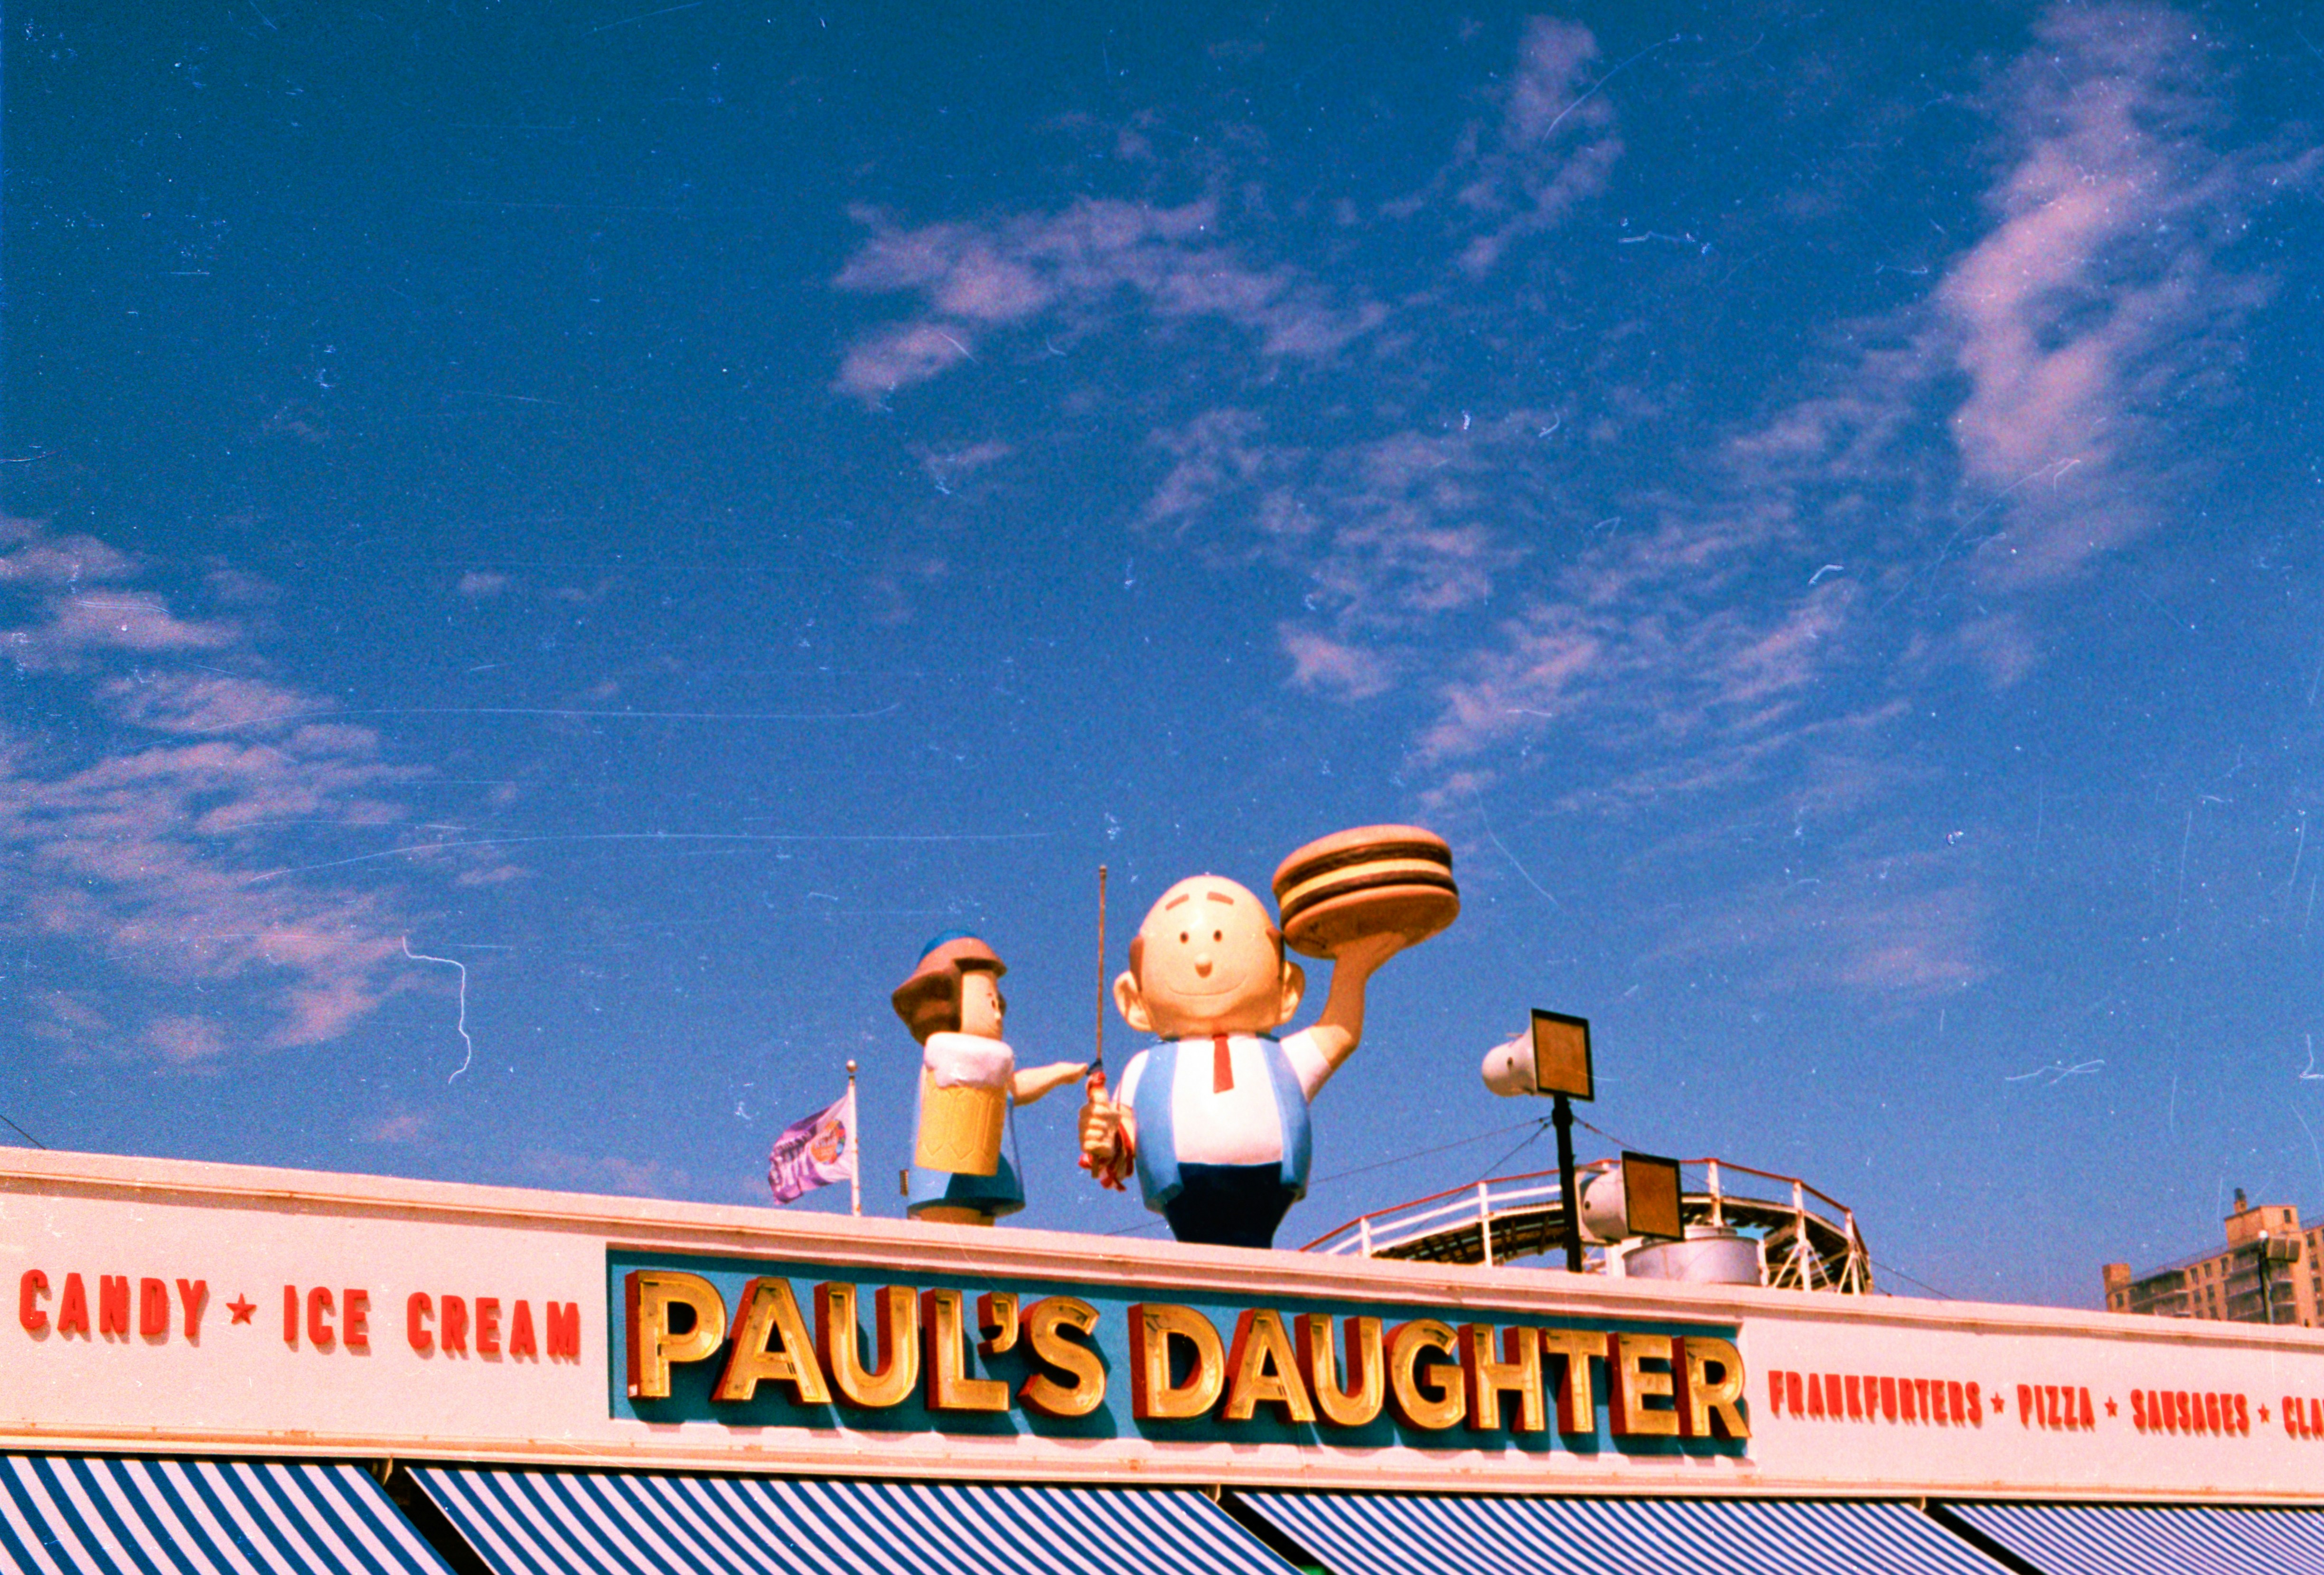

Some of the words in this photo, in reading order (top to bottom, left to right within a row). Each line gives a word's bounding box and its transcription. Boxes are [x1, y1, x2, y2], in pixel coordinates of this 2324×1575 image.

[19, 1269, 209, 1341] CANDY
[283, 1284, 369, 1352] ICE
[406, 1292, 581, 1359] CREAM
[625, 1270, 1106, 1416] PAUL'S
[1128, 1303, 1751, 1437] DAUGHTER
[1768, 1370, 1983, 1426] FRANKFURTERS
[2016, 1384, 2096, 1429] PIZZA
[2130, 1389, 2250, 1434] SAUSAGES
[2282, 1396, 2324, 1439] CLA
